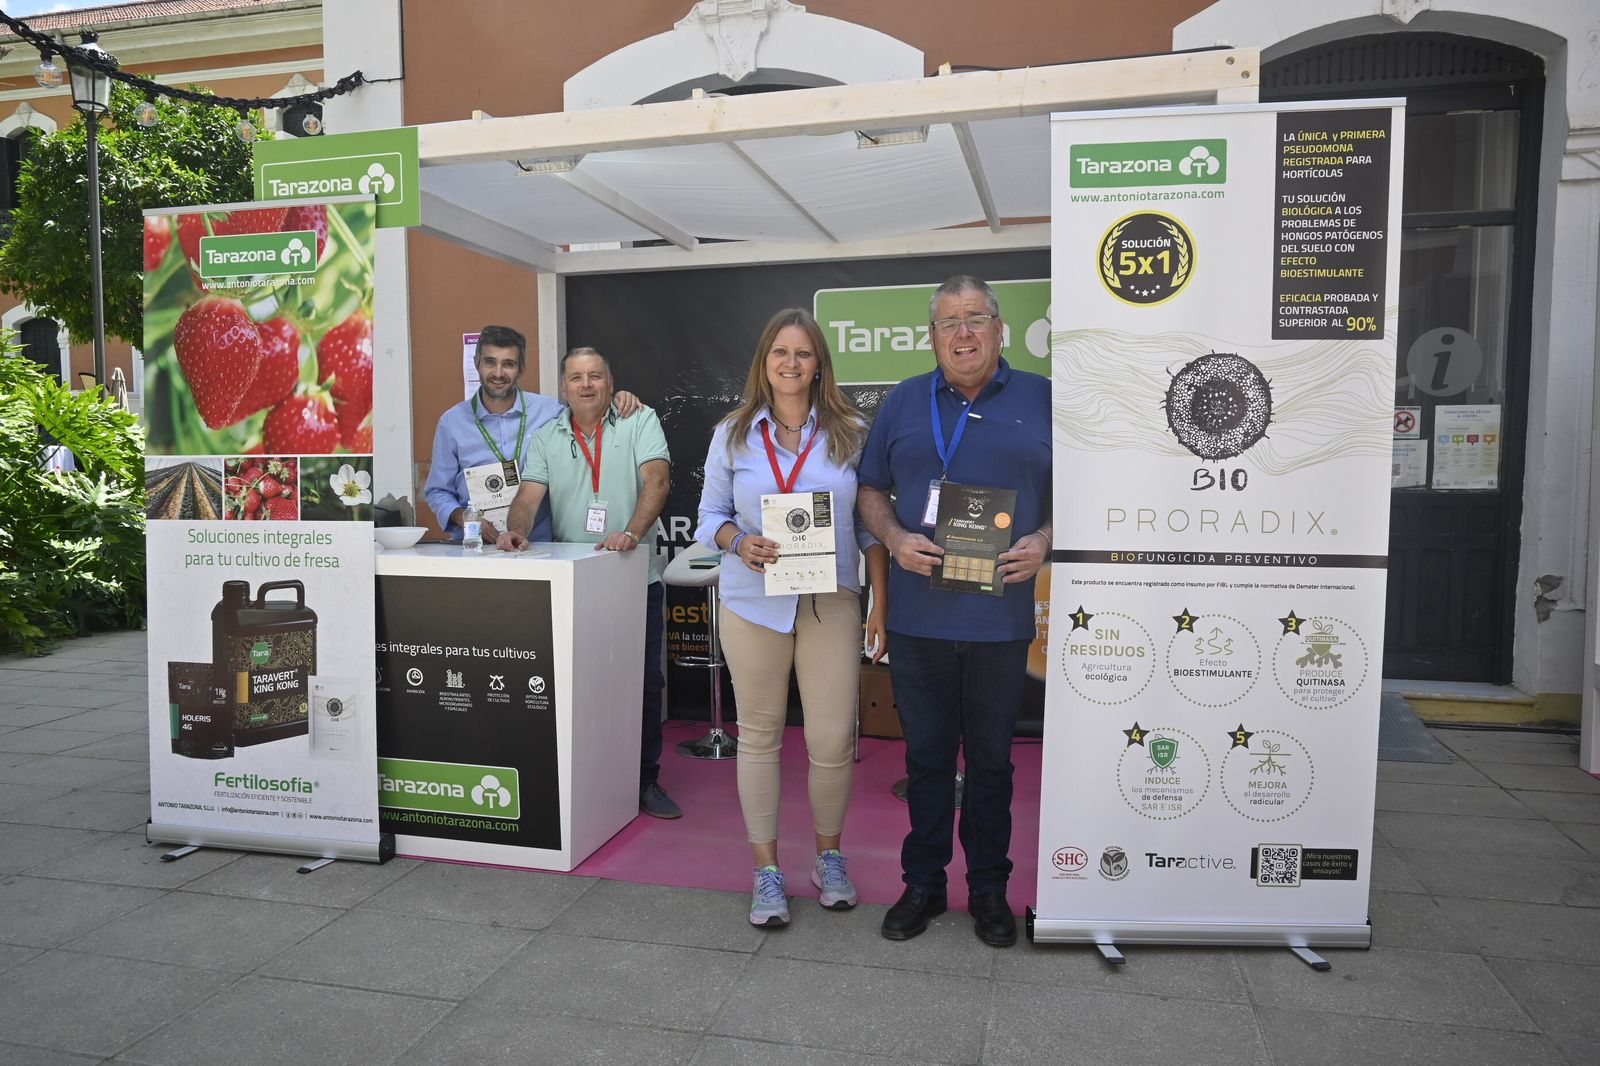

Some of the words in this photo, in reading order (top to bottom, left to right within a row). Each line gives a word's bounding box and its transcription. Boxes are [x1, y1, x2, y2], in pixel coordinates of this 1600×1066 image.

[1283, 133, 1296, 142] LA
[1297, 130, 1328, 142] ÚNICA
[1332, 133, 1338, 142] y
[1340, 130, 1386, 140] PRIMERA
[1283, 143, 1354, 154] PSEUDOMONA
[1076, 157, 1172, 174] Tarazona
[1283, 156, 1344, 166] REGISTRADA
[1346, 156, 1372, 165] PARA
[1282, 167, 1343, 179] HORTÍCOLAS
[269, 176, 353, 197] Tarazona
[1070, 189, 1225, 203] www.antoniotarazona.com
[1282, 195, 1295, 204] TU
[1297, 192, 1346, 203] SOLUCIÓN
[1282, 205, 1333, 216] BIOLÓGICA
[1334, 207, 1341, 215] A
[1344, 206, 1362, 215] LOS
[1281, 219, 1341, 229] PROBLEMAS
[1343, 219, 1357, 228] DE
[1281, 232, 1323, 241] HONGOS
[1325, 229, 1384, 240] PATÓGENOS
[1121, 236, 1171, 249] SOLUCIÓN
[1281, 244, 1299, 253] DEL
[1301, 244, 1332, 252] SUELO
[1334, 244, 1355, 252] CON
[205, 249, 276, 265] Tarazona
[1119, 250, 1170, 276] 5x1
[1280, 256, 1317, 266] EFECTO
[1280, 269, 1364, 278] BIOESTIMULANTE
[202, 276, 316, 290] www.antoniotarazona.com
[1280, 294, 1322, 303] EFICACIA
[1324, 293, 1370, 302] PROBADA
[1372, 293, 1379, 302] Y
[1280, 306, 1349, 315] CONTRASTADA
[1279, 318, 1328, 327] SUPERIOR
[1331, 318, 1344, 327] AL
[1346, 316, 1377, 332] 90%
[1190, 468, 1248, 492] BIO
[188, 528, 260, 544] Soluciones
[263, 530, 333, 548] integrales
[185, 554, 214, 569] para
[218, 553, 232, 566] tu
[235, 552, 280, 567] cultivo
[284, 553, 300, 567] de
[304, 553, 340, 568] fresa
[1111, 552, 1216, 563] BIOFUNGICIDA
[1225, 555, 1317, 565] PREVENTIVO
[1143, 580, 1170, 588] registrado
[1076, 613, 1083, 625] 1
[1181, 615, 1190, 628] 2
[1287, 618, 1297, 631] 3
[1094, 629, 1120, 641] SIN
[389, 641, 443, 656] integrales
[445, 646, 470, 657] para
[472, 646, 490, 657] tus
[492, 647, 536, 660] cultivos
[1070, 645, 1145, 657] RESIDUOS
[1081, 662, 1132, 672] Agricultura
[1200, 659, 1227, 667] Efecto
[1085, 673, 1128, 683] ecológica
[1173, 669, 1252, 678] BIOESTIMULANTE
[1300, 669, 1343, 677] PRODUCE
[253, 683, 274, 694] KING
[276, 679, 299, 691] KONG
[1296, 678, 1346, 687] QUITINASA
[1294, 688, 1311, 696] para
[1313, 688, 1345, 696] proteger
[182, 714, 211, 722] HOLERIS
[1131, 728, 1141, 742] 4
[1236, 731, 1245, 744] 5
[1145, 777, 1181, 785] INDUCE
[1249, 781, 1287, 789] MEJORA
[1145, 786, 1193, 794] mecanismos
[214, 791, 251, 801] FERTILIZACIÓN
[281, 795, 313, 804] SOSTENIBLE
[1250, 798, 1285, 806] radicular
[1142, 803, 1158, 811] SAR
[1168, 803, 1182, 811] ISR
[221, 806, 279, 816] info@antoniotarazona.com
[309, 813, 374, 824] www.antoniotarazona.com
[381, 811, 519, 832] ww.antoniotarazona.com
[1056, 853, 1084, 866] SHC
